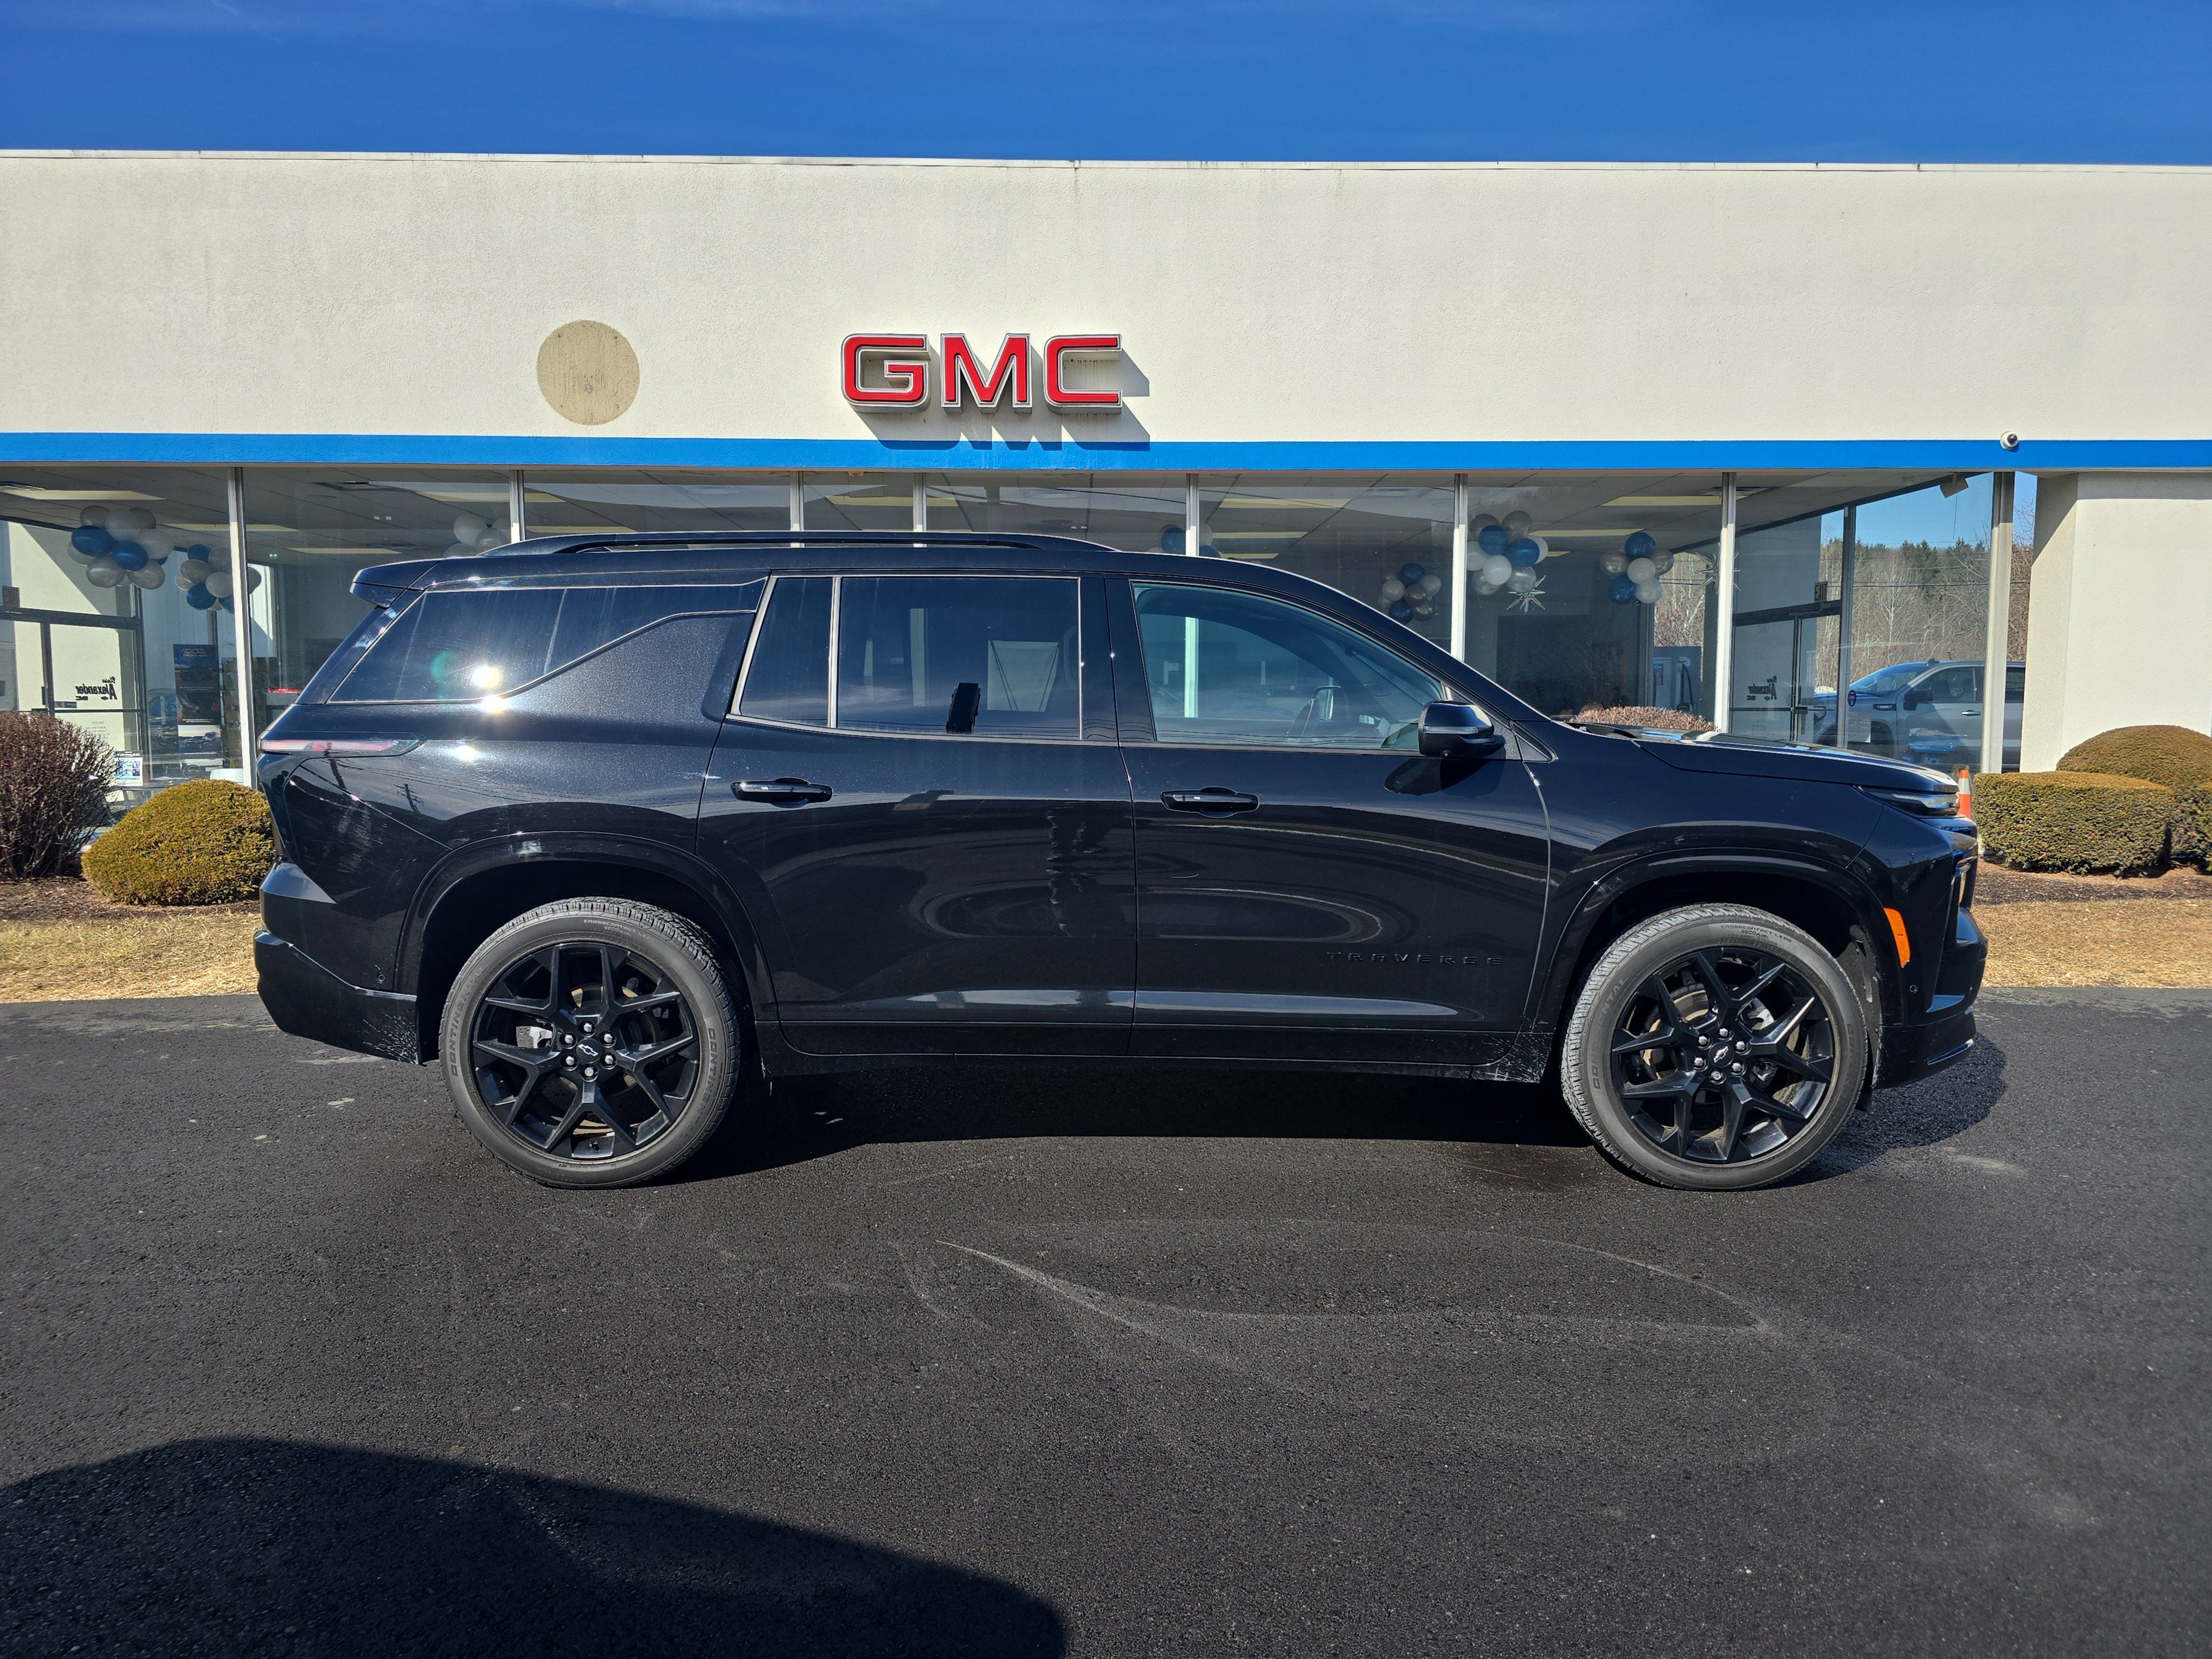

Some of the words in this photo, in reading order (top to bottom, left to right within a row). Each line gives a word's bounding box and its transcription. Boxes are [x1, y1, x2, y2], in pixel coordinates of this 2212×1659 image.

[841, 333, 1123, 408] GMC
[1326, 951, 1502, 966] TRAVERSE
[1591, 976, 1629, 1090] CONTINENTAL
